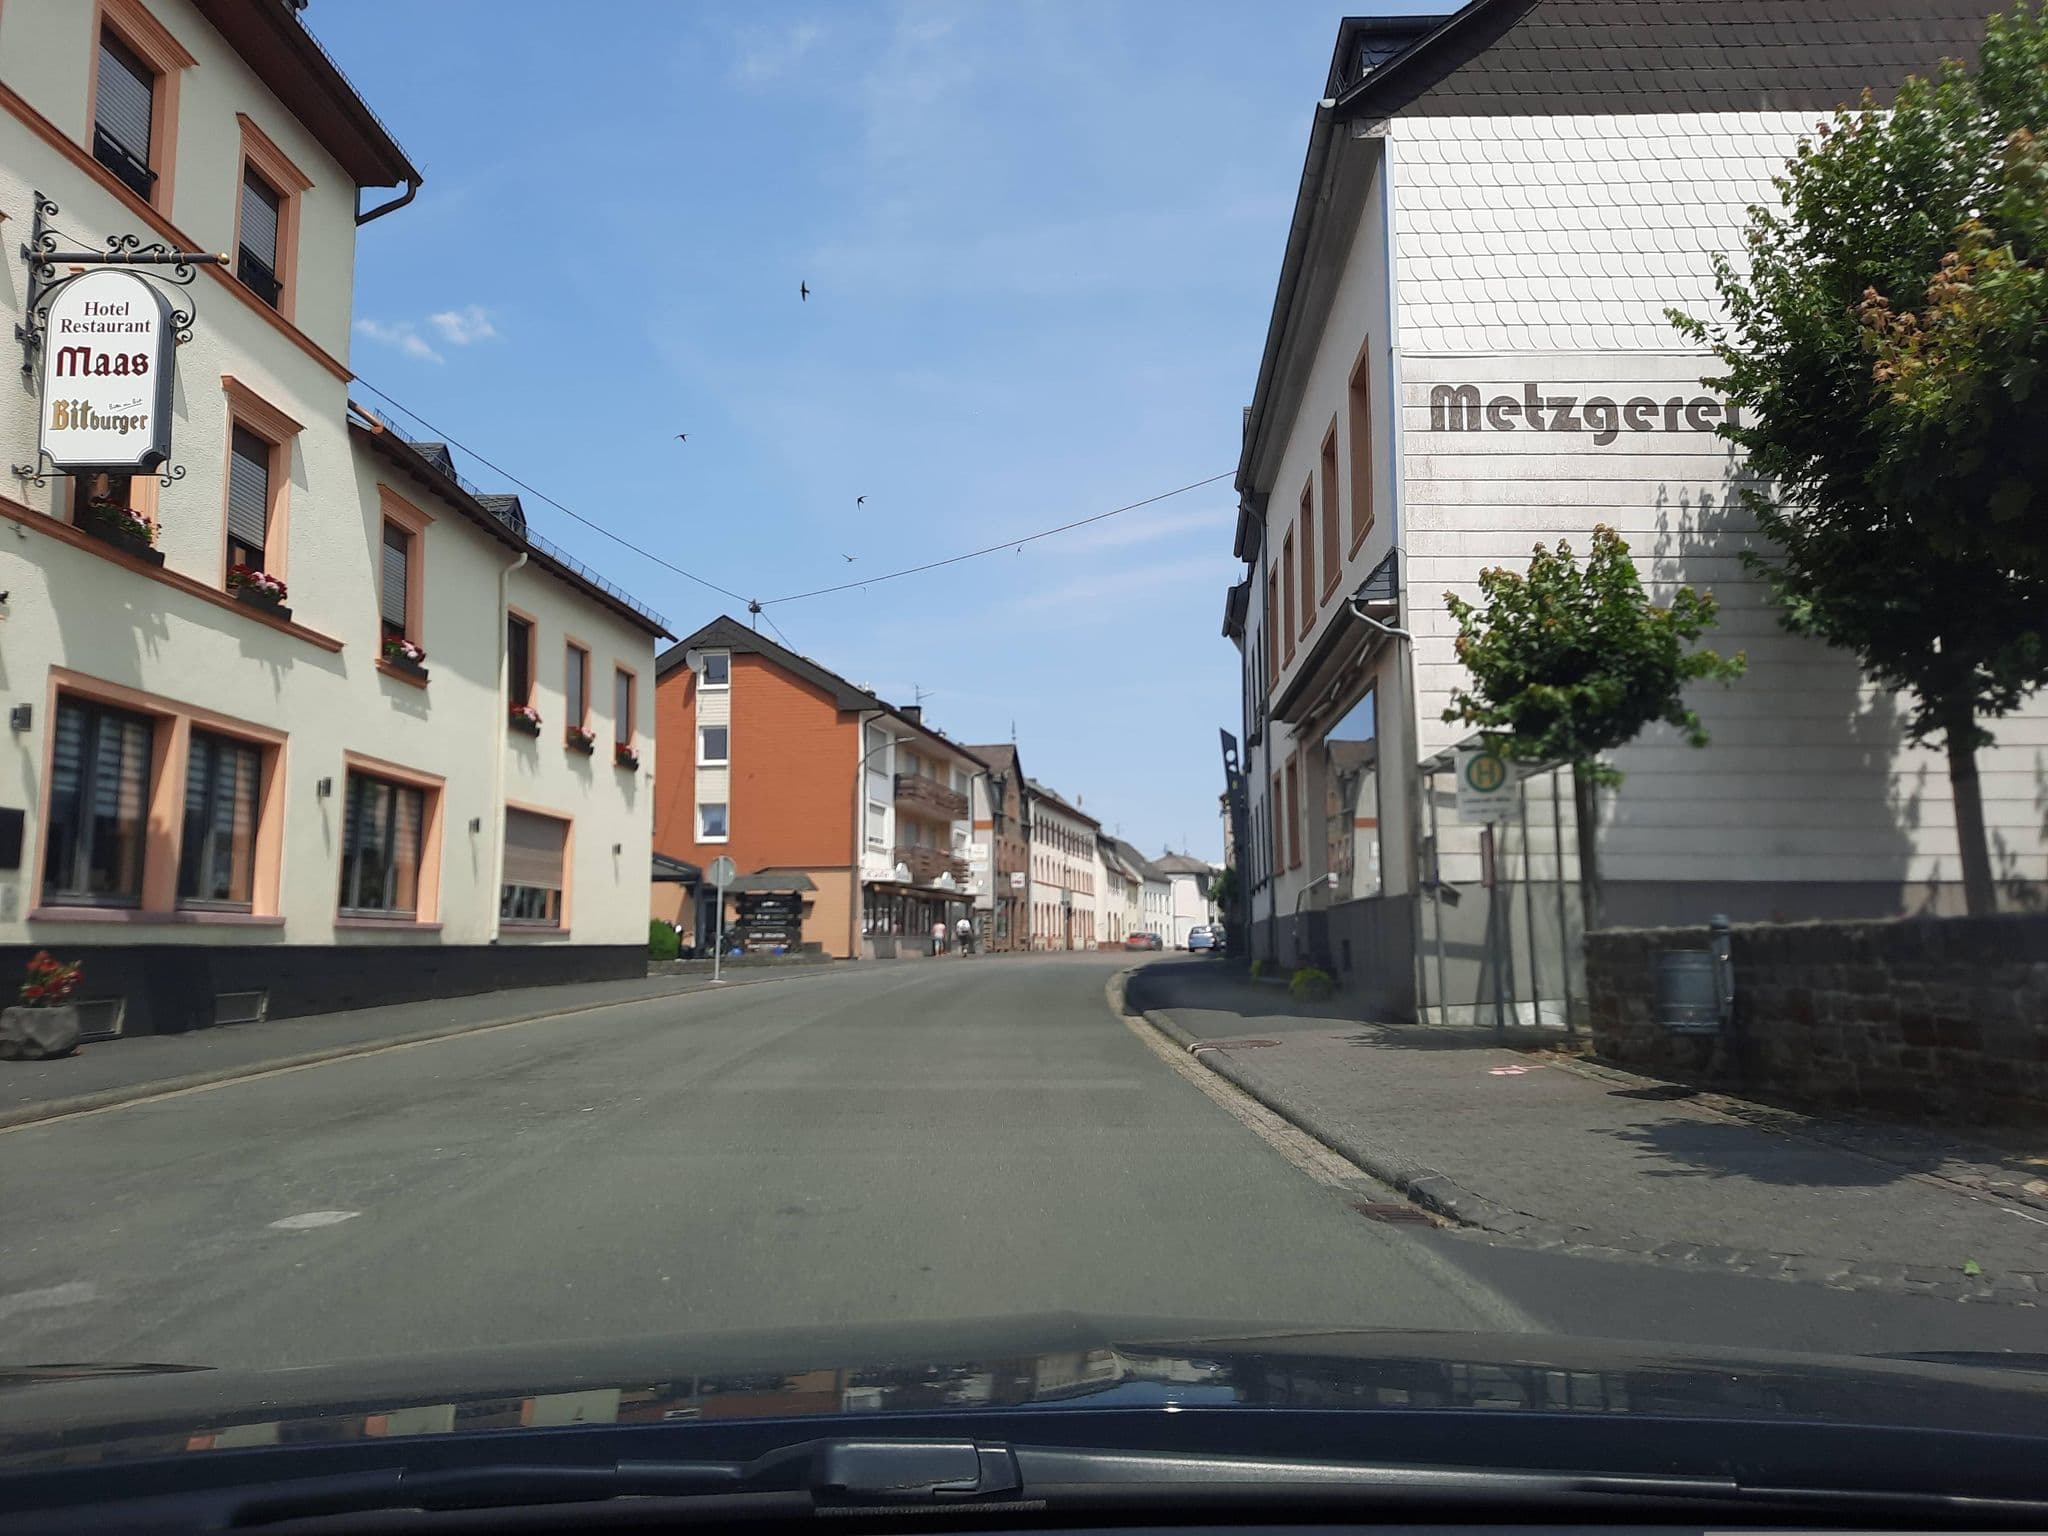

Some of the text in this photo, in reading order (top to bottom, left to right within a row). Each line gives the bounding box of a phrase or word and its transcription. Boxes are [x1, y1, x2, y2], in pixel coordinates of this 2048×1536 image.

[84, 301, 130, 317] Hotel
[60, 318, 151, 333] Restaurant
[56, 346, 149, 377] Maas
[49, 399, 149, 435] Bitburger
